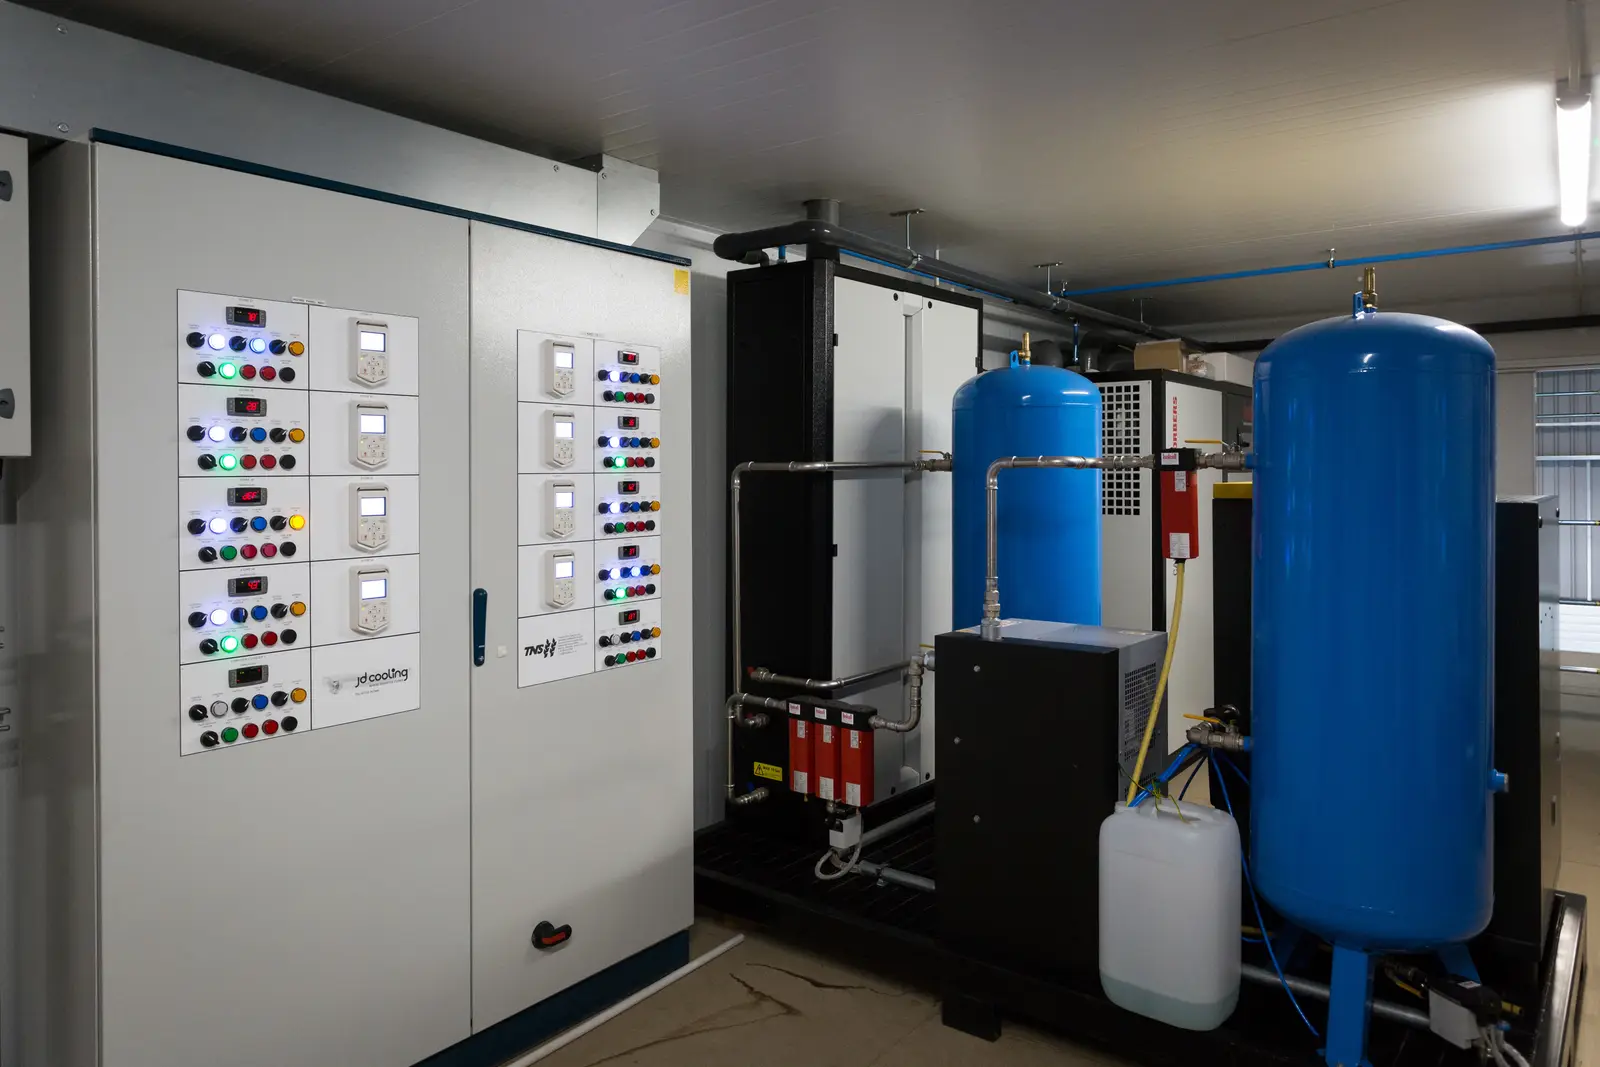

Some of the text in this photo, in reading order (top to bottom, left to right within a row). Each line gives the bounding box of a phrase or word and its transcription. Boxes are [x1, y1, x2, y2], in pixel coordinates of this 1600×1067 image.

[524, 644, 544, 657] TNS
[355, 672, 367, 688] jd
[369, 668, 408, 682] cooling
